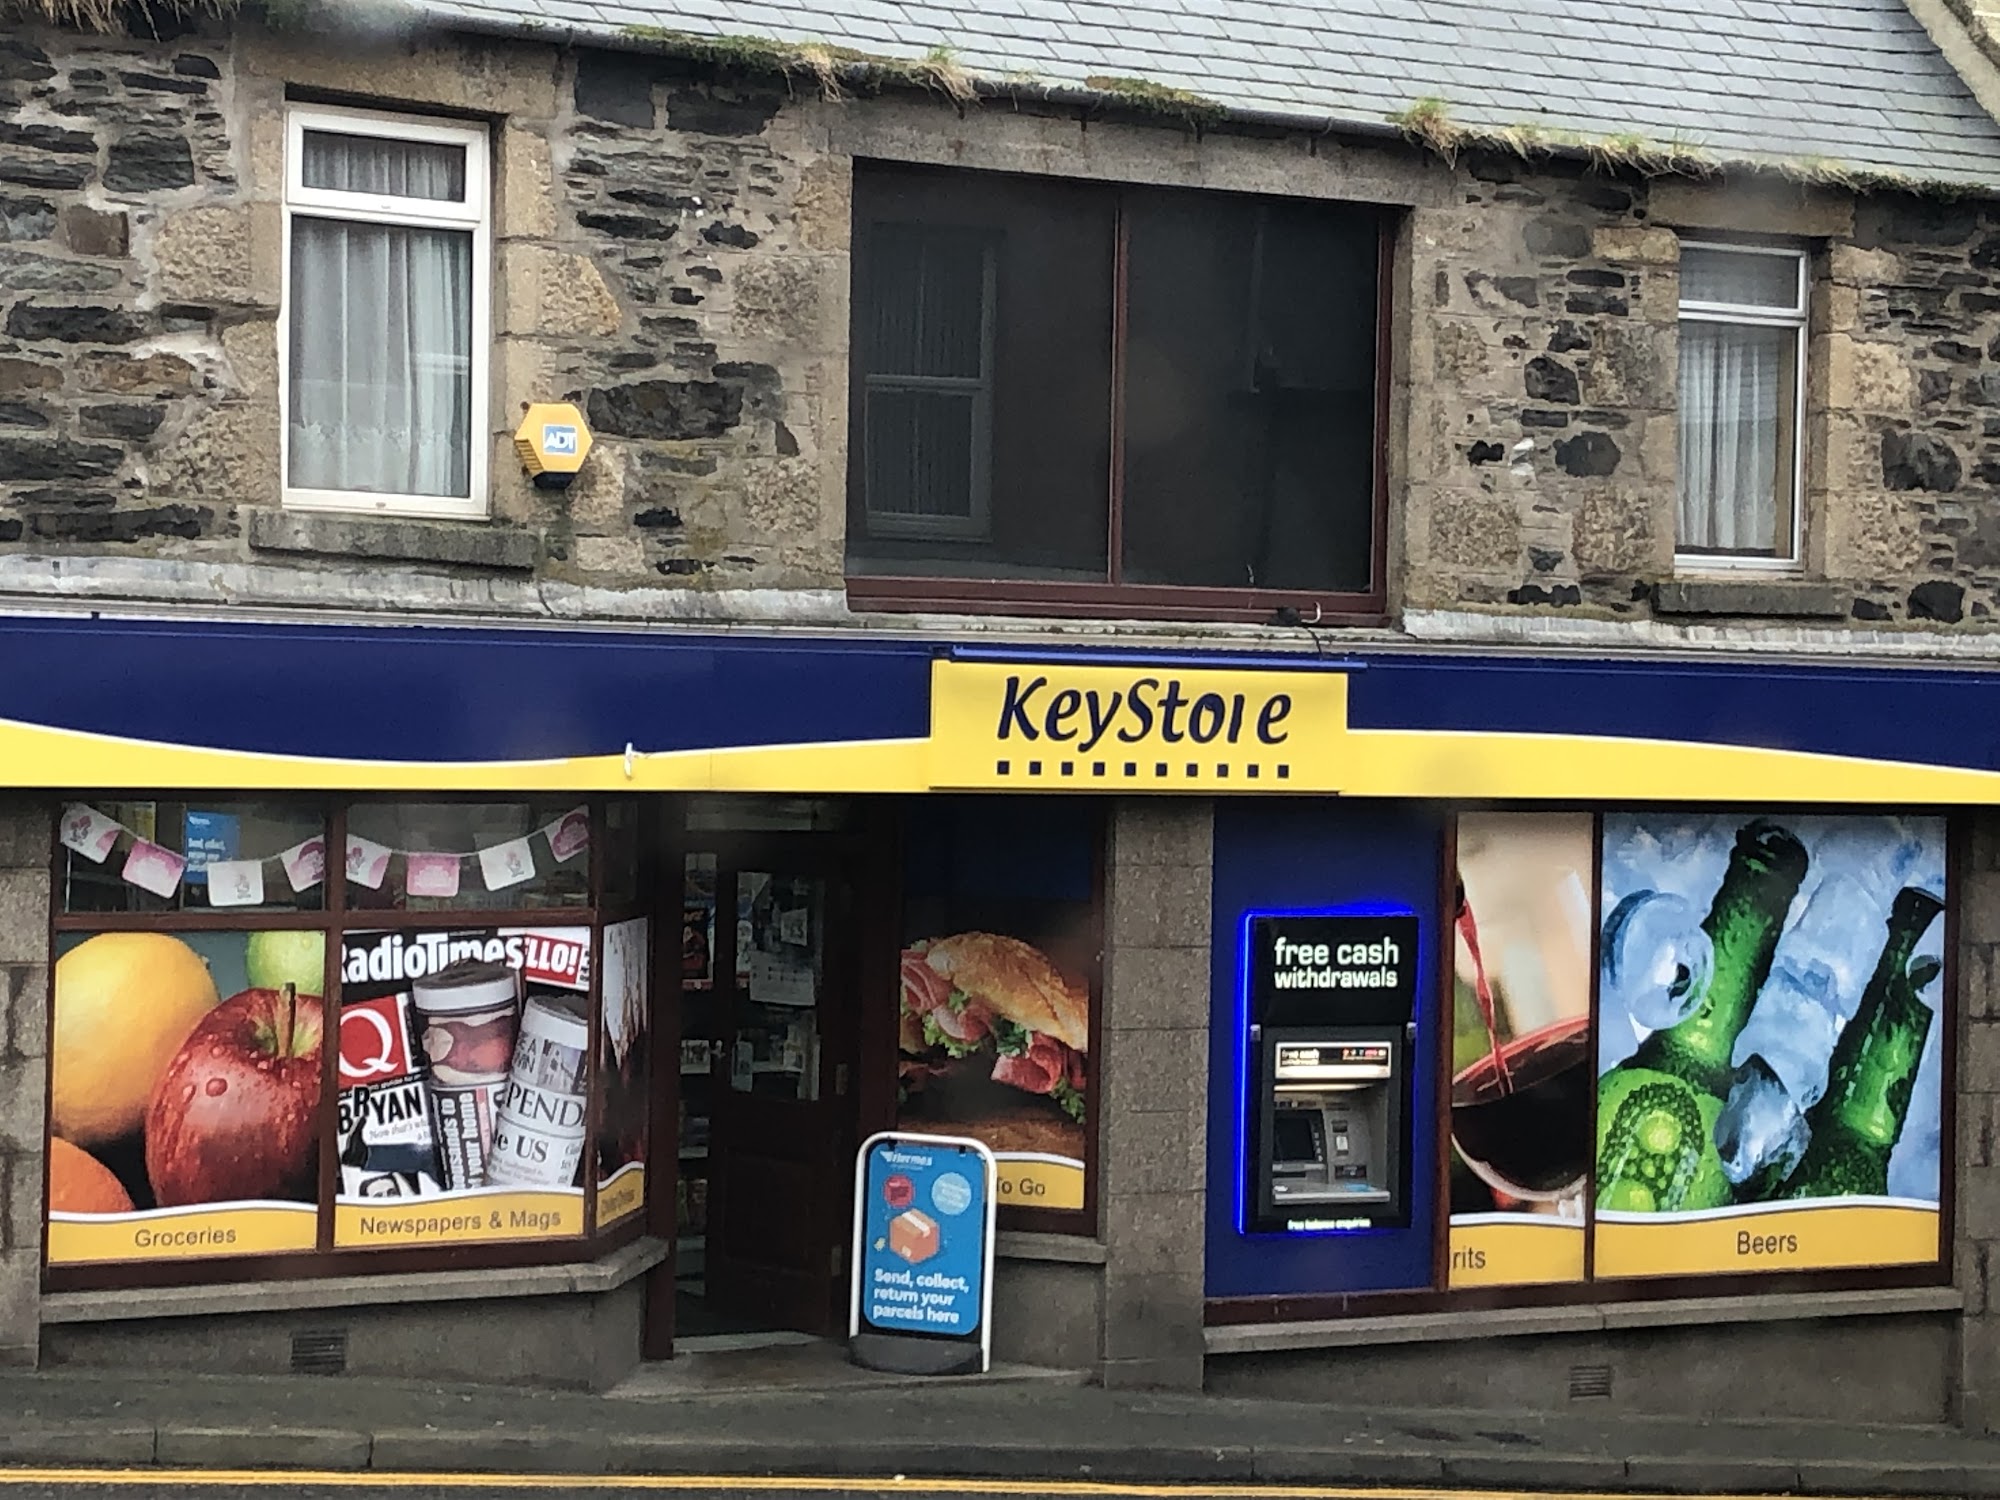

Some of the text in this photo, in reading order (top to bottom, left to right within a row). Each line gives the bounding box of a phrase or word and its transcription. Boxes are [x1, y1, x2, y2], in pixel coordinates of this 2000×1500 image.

[543, 431, 577, 450] ADT
[997, 675, 1292, 753] KeyStore
[1274, 936, 1400, 966] free cash
[1274, 966, 1399, 989] withdrawals
[339, 1008, 399, 1078] Q
[339, 1086, 423, 1136] BRYAN
[506, 1082, 587, 1128] PEND
[515, 1134, 549, 1163] US
[1020, 1177, 1045, 1196] Go
[360, 1209, 562, 1237] Newspapers & Mags
[135, 1226, 237, 1248] Groceries
[1737, 1230, 1798, 1255] Beers
[874, 1268, 970, 1294] Send, collect,
[873, 1287, 955, 1307] return your
[872, 1304, 960, 1324] parcels here
